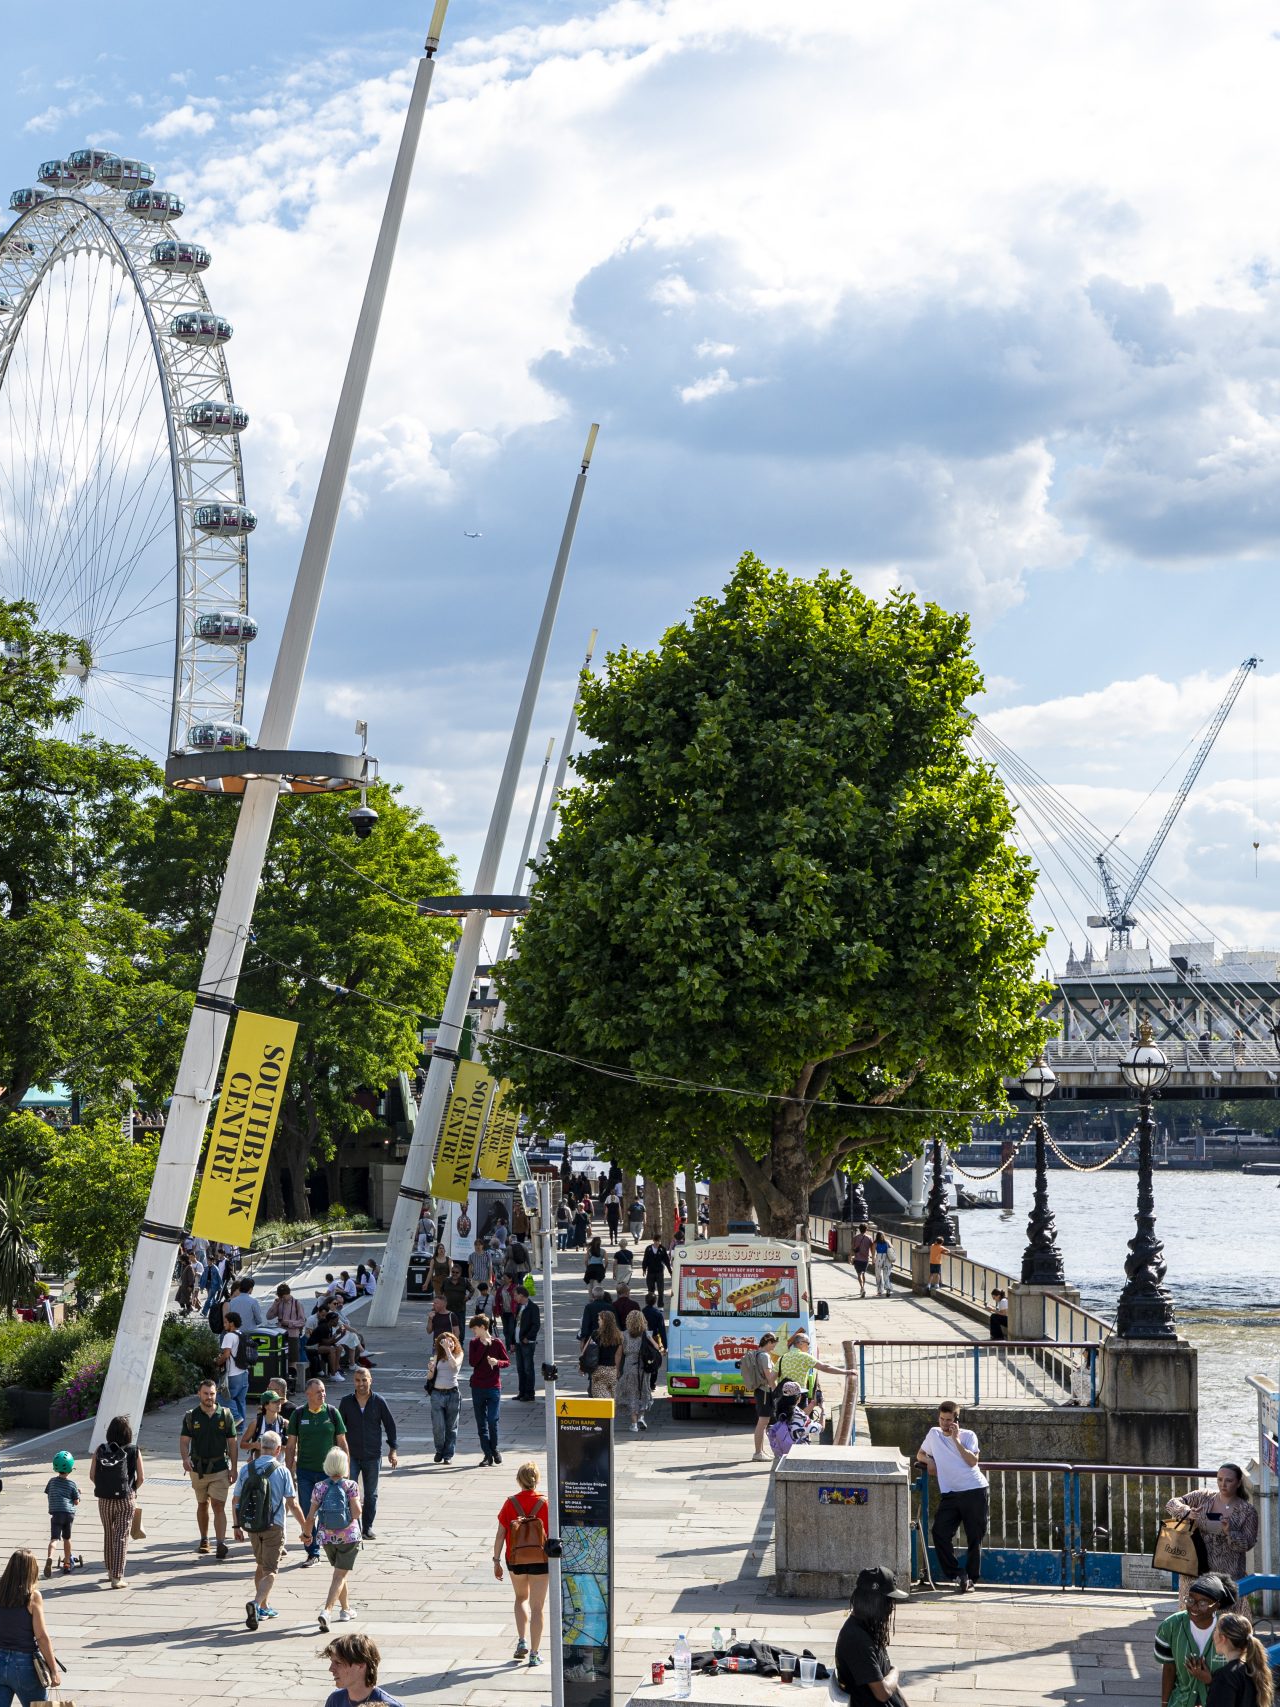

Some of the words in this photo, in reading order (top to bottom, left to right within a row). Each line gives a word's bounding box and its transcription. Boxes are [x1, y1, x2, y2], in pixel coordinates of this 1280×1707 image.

[210, 1072, 252, 1183] CENTRE
[228, 1045, 285, 1221] SOUTHBANK
[441, 1096, 468, 1165] CENTRE
[452, 1080, 489, 1188] SOUTHBANK
[696, 1248, 731, 1260] SUPER
[732, 1248, 762, 1260] SOFT
[763, 1249, 781, 1260] ICE
[718, 1348, 731, 1356] ICE
